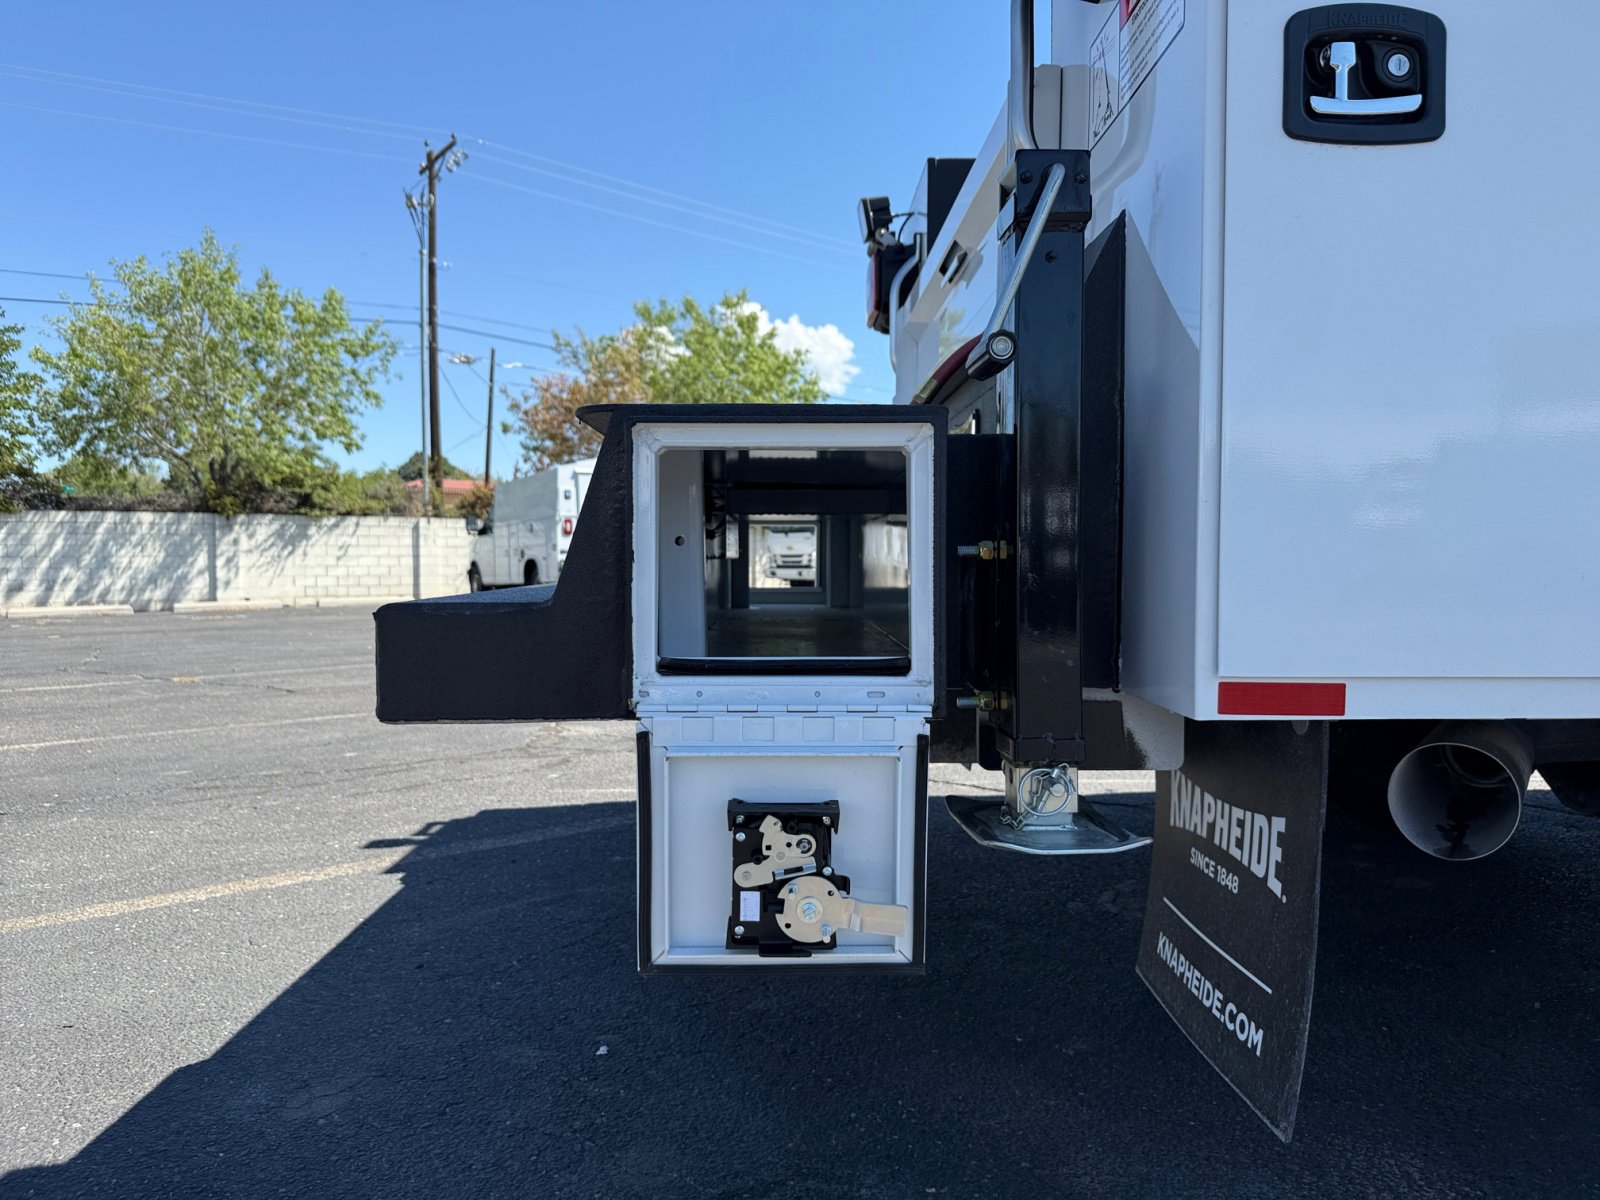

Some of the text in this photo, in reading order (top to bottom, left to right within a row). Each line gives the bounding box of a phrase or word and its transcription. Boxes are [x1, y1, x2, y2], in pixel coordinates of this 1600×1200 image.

[1328, 10, 1410, 26] KNAPHEIDE
[1190, 847, 1239, 894] SINCE 1848
[1157, 932, 1264, 1058] KNAPHEIDE.COM
